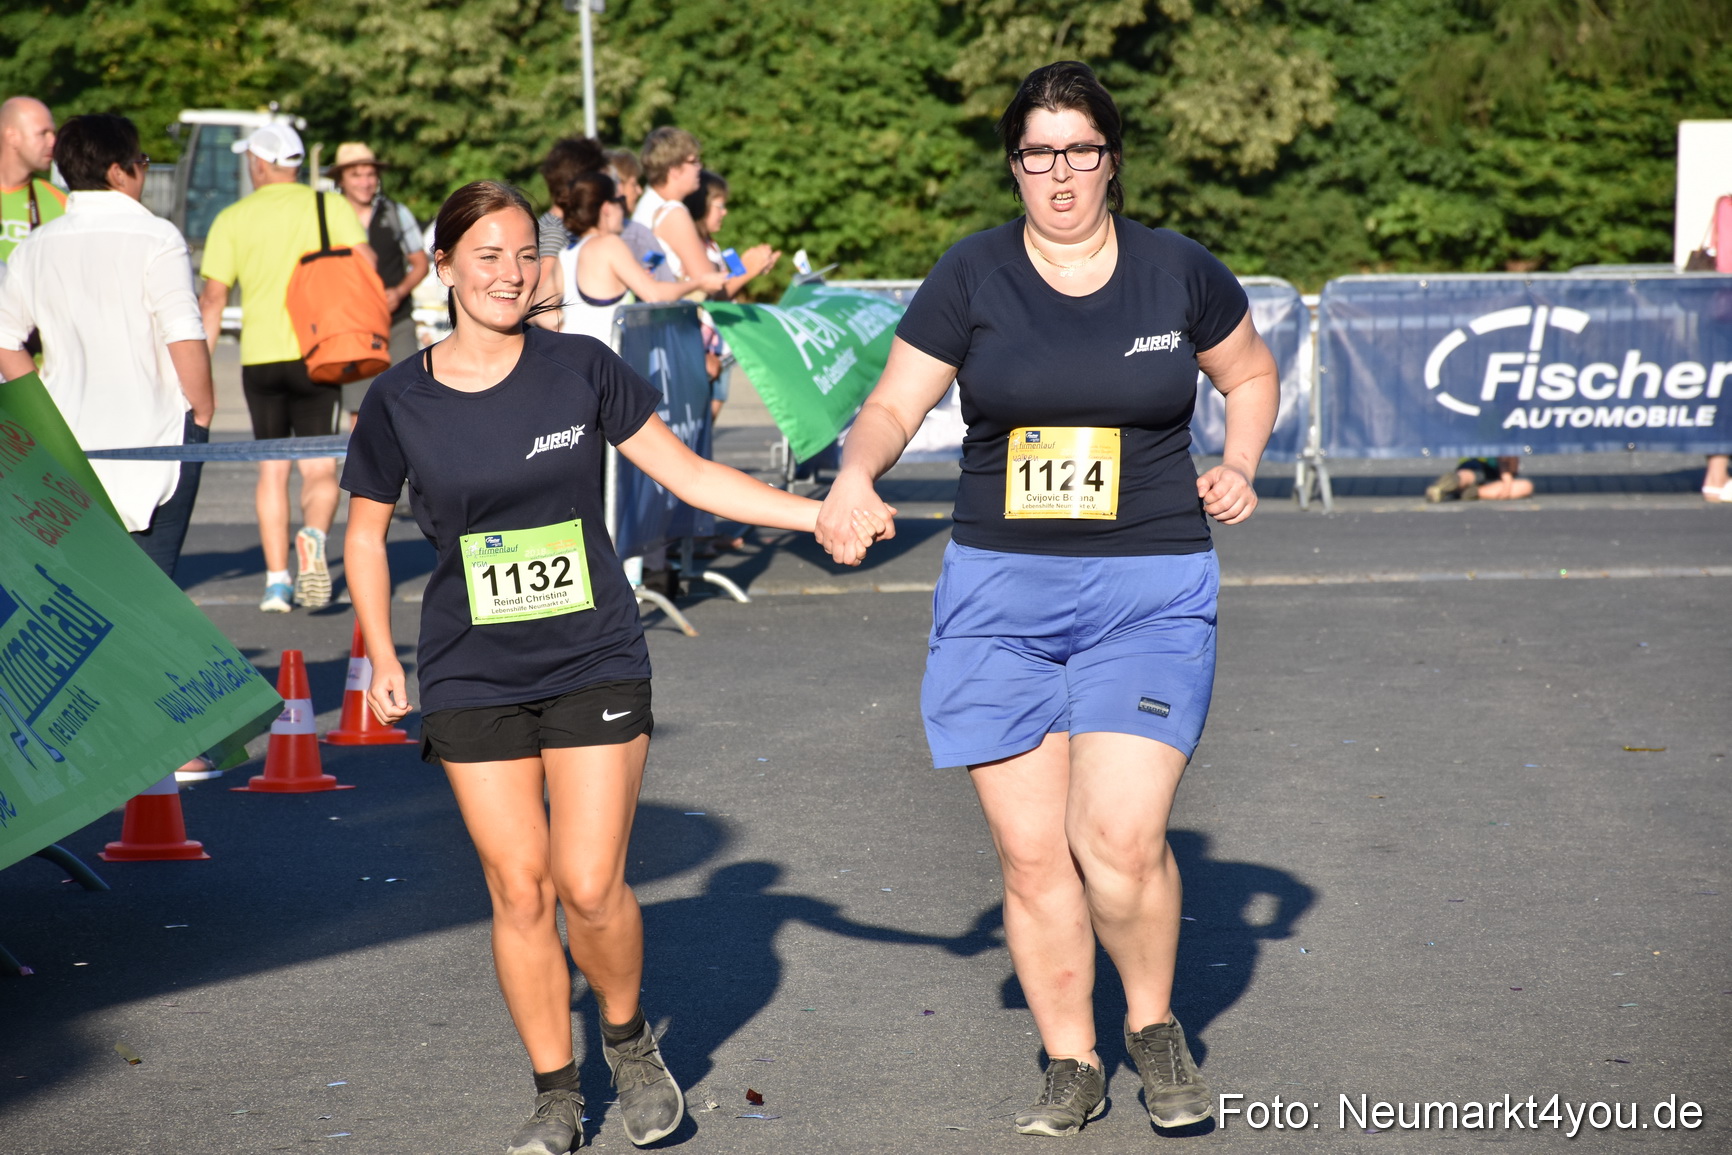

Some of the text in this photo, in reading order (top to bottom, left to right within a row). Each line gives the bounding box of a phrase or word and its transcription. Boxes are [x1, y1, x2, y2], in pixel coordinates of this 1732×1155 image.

[1124, 334, 1171, 357] JURA
[1480, 349, 1732, 401] Fischer
[1503, 404, 1717, 429] AUTOMOBILE
[525, 429, 571, 460] JURA
[1019, 441, 1056, 450] firmenlauf
[1019, 460, 1104, 491] 1124
[1026, 493, 1060, 503] Cvijovic
[11, 494, 83, 549] laufen
[478, 544, 518, 556] firmenlauf
[482, 556, 573, 596] 1132
[491, 605, 527, 614] Lebenshilfe
[529, 601, 559, 610] Neumarkt
[560, 598, 571, 606] e.V.
[494, 590, 568, 606] Reindl Christina
[48, 684, 101, 747] neumarkt
